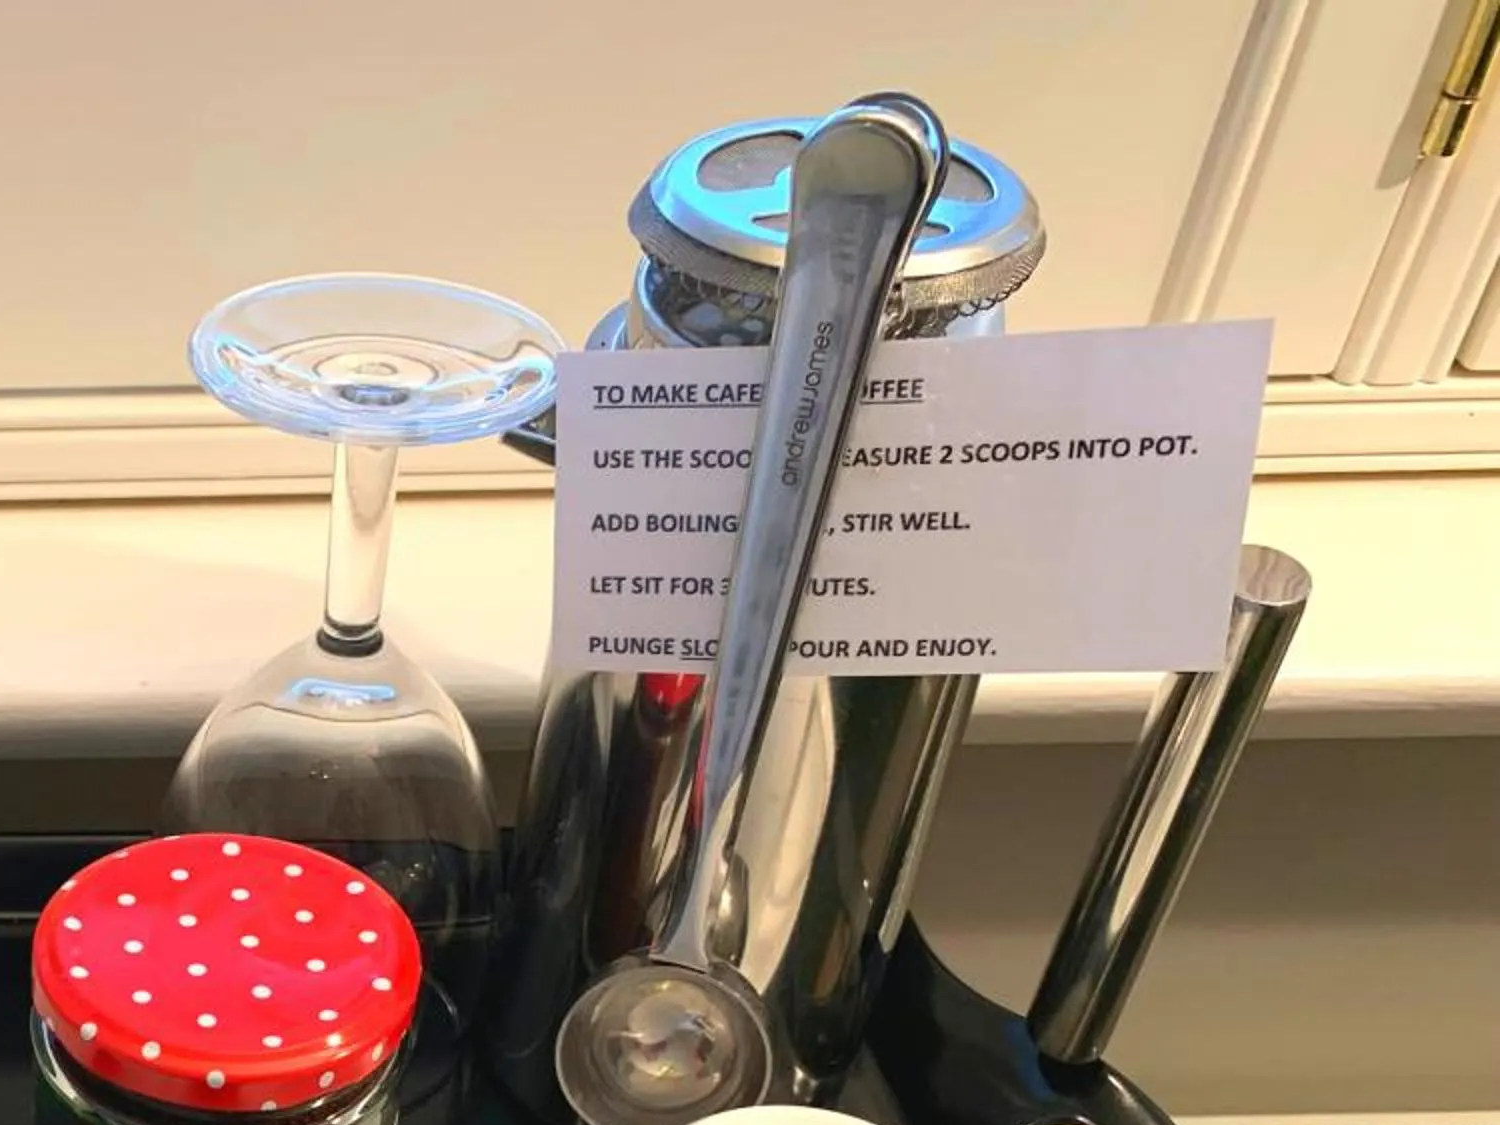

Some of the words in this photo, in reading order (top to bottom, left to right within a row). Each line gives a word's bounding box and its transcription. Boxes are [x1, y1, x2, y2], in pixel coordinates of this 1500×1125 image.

[593, 384, 625, 405] TO
[631, 383, 698, 404] MAKE
[704, 382, 764, 403] CAFE
[861, 379, 925, 399] FFEE
[593, 449, 635, 469] USE
[641, 449, 684, 469] THE
[689, 449, 752, 469] SCOO
[842, 446, 932, 468] EASURE
[939, 445, 953, 464] 2
[960, 440, 1060, 463] SCOOPS
[1068, 438, 1131, 459] INTO
[1139, 435, 1198, 456] POT.
[591, 514, 639, 533] ADD
[646, 514, 739, 533] BOILING
[842, 512, 893, 533] STIR
[900, 511, 971, 531] WELL.
[590, 576, 626, 594] LET
[631, 576, 665, 595] SIT
[670, 577, 714, 595] FOR
[806, 577, 877, 597] UTES.
[589, 636, 675, 655] PLUNGE
[856, 639, 909, 658] AND
[915, 638, 998, 657] ENJOY.
